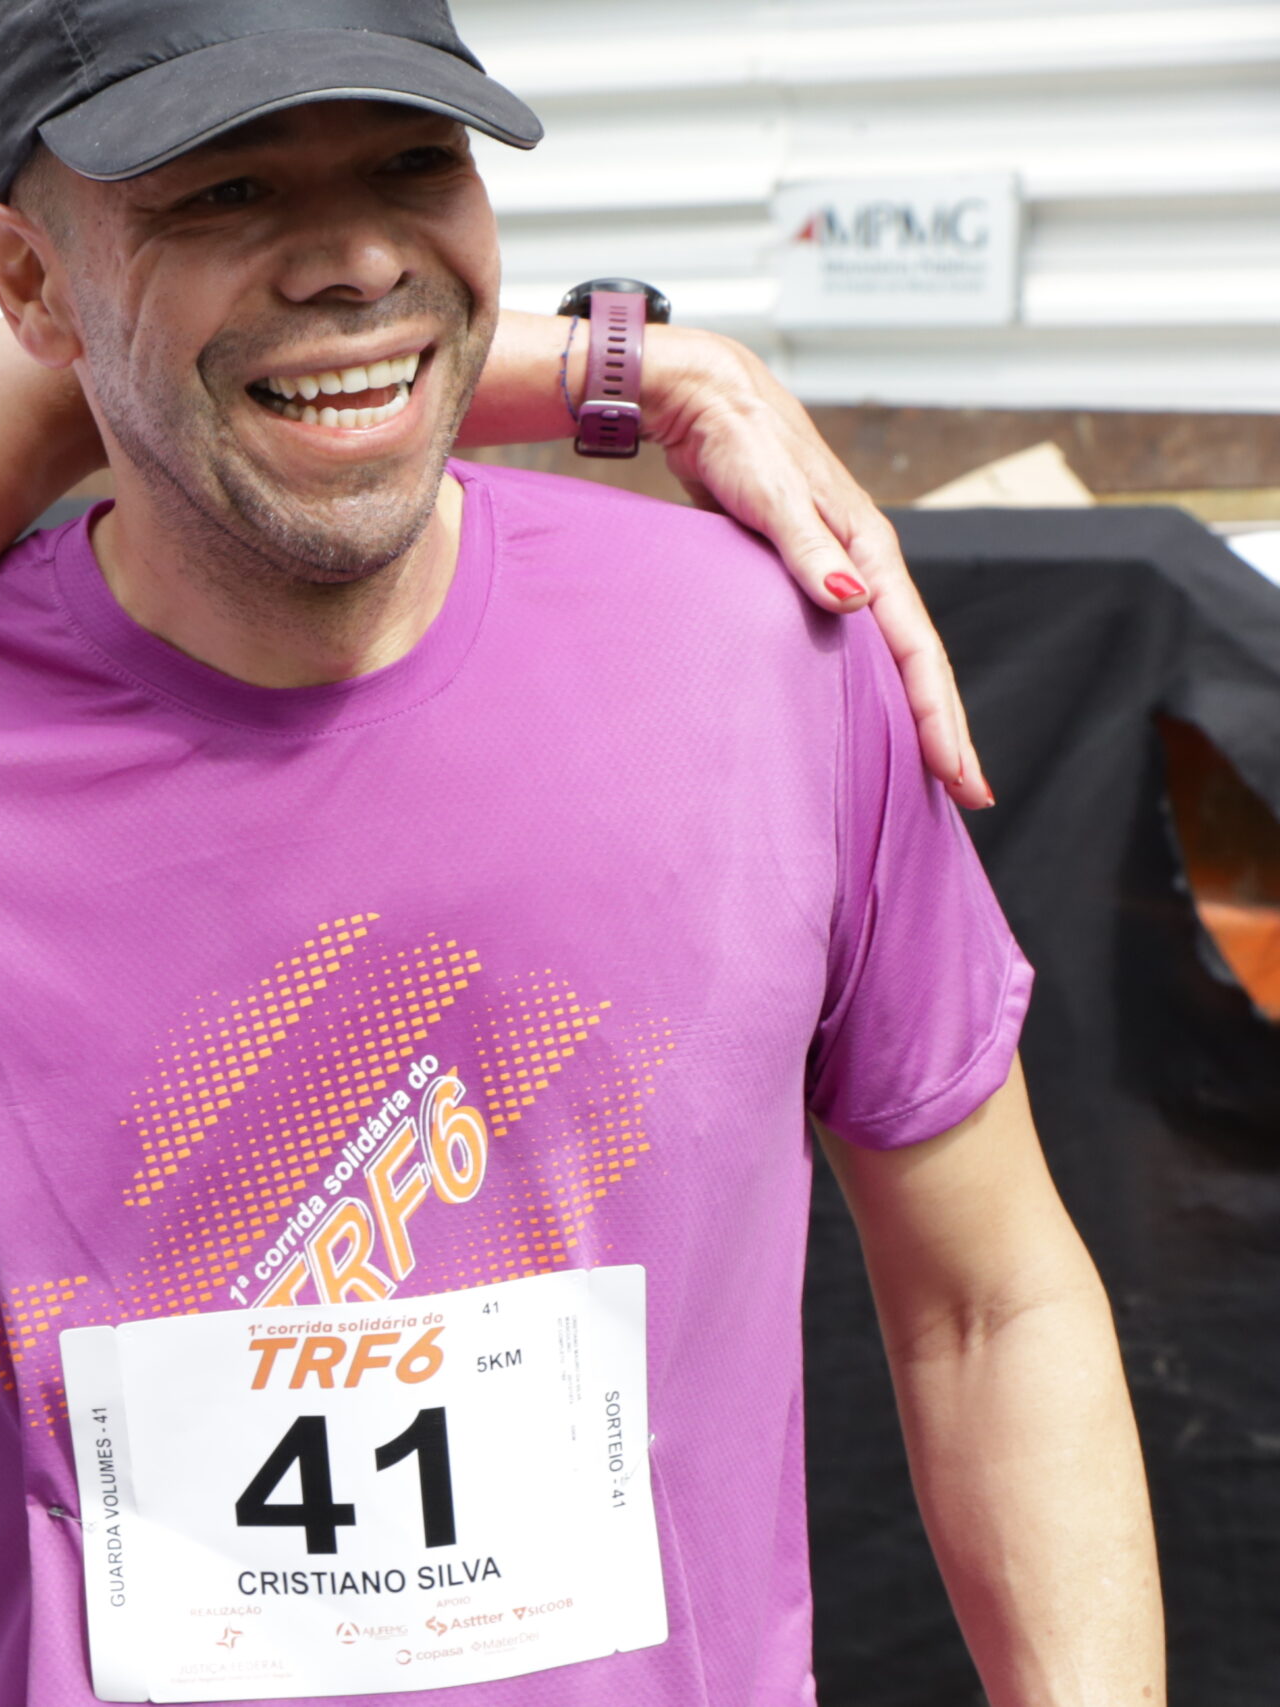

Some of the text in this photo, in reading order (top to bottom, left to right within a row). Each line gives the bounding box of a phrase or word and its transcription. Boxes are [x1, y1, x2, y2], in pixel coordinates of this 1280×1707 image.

[254, 1195, 327, 1280] corrida
[323, 1089, 411, 1195] solidária
[408, 1054, 439, 1089] do
[267, 1321, 333, 1335] corrida
[338, 1313, 417, 1333] solidária
[422, 1312, 444, 1326] do
[482, 1301, 499, 1315] 41
[248, 1326, 446, 1390] TRF6
[477, 1349, 522, 1373] 5KM
[91, 1407, 107, 1429] 41
[605, 1390, 624, 1473] SORTEIO
[96, 1437, 120, 1520] VOLUMES
[235, 1406, 457, 1554] 41
[612, 1489, 626, 1509] 41
[106, 1524, 126, 1607] GUARDA
[237, 1556, 501, 1596] CRISTIANO SILVA
[528, 1597, 573, 1617] SICOOB
[416, 1646, 464, 1662] copasa
